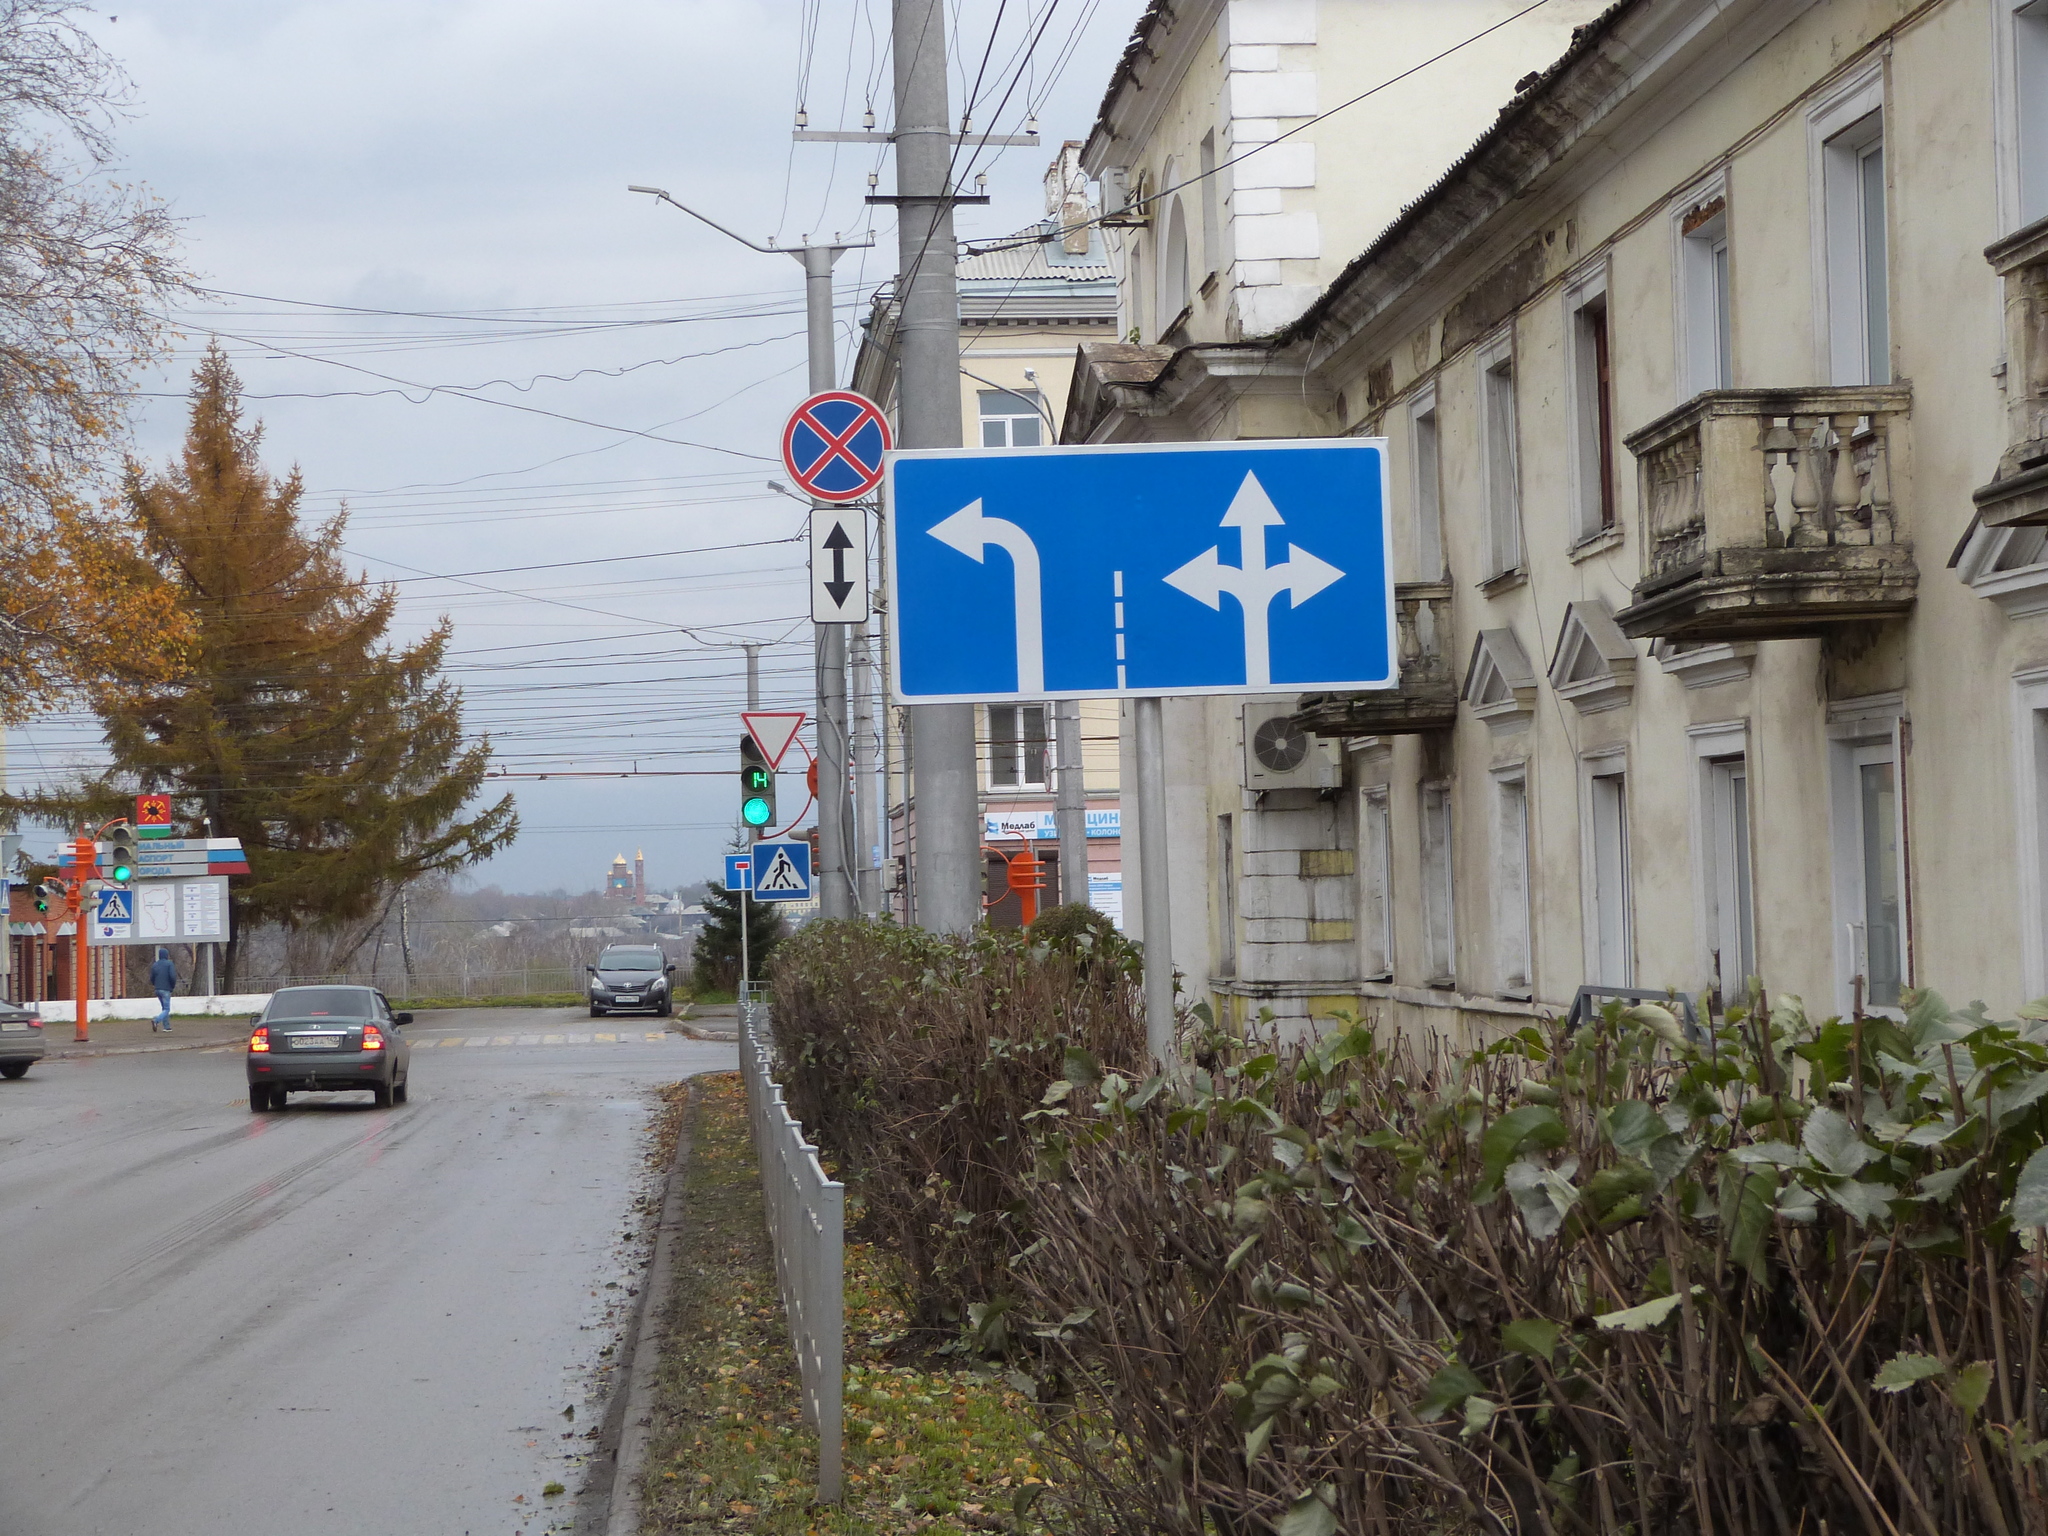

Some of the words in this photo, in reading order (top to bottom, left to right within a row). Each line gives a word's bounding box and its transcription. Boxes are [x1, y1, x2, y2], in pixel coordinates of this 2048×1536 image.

[753, 772, 768, 788] 14
[1001, 820, 1035, 830] Медлаб
[138, 840, 184, 850] ИАЛЬНЫЙ
[138, 853, 174, 863] АСПОРТ
[138, 866, 172, 876] ОРОДА
